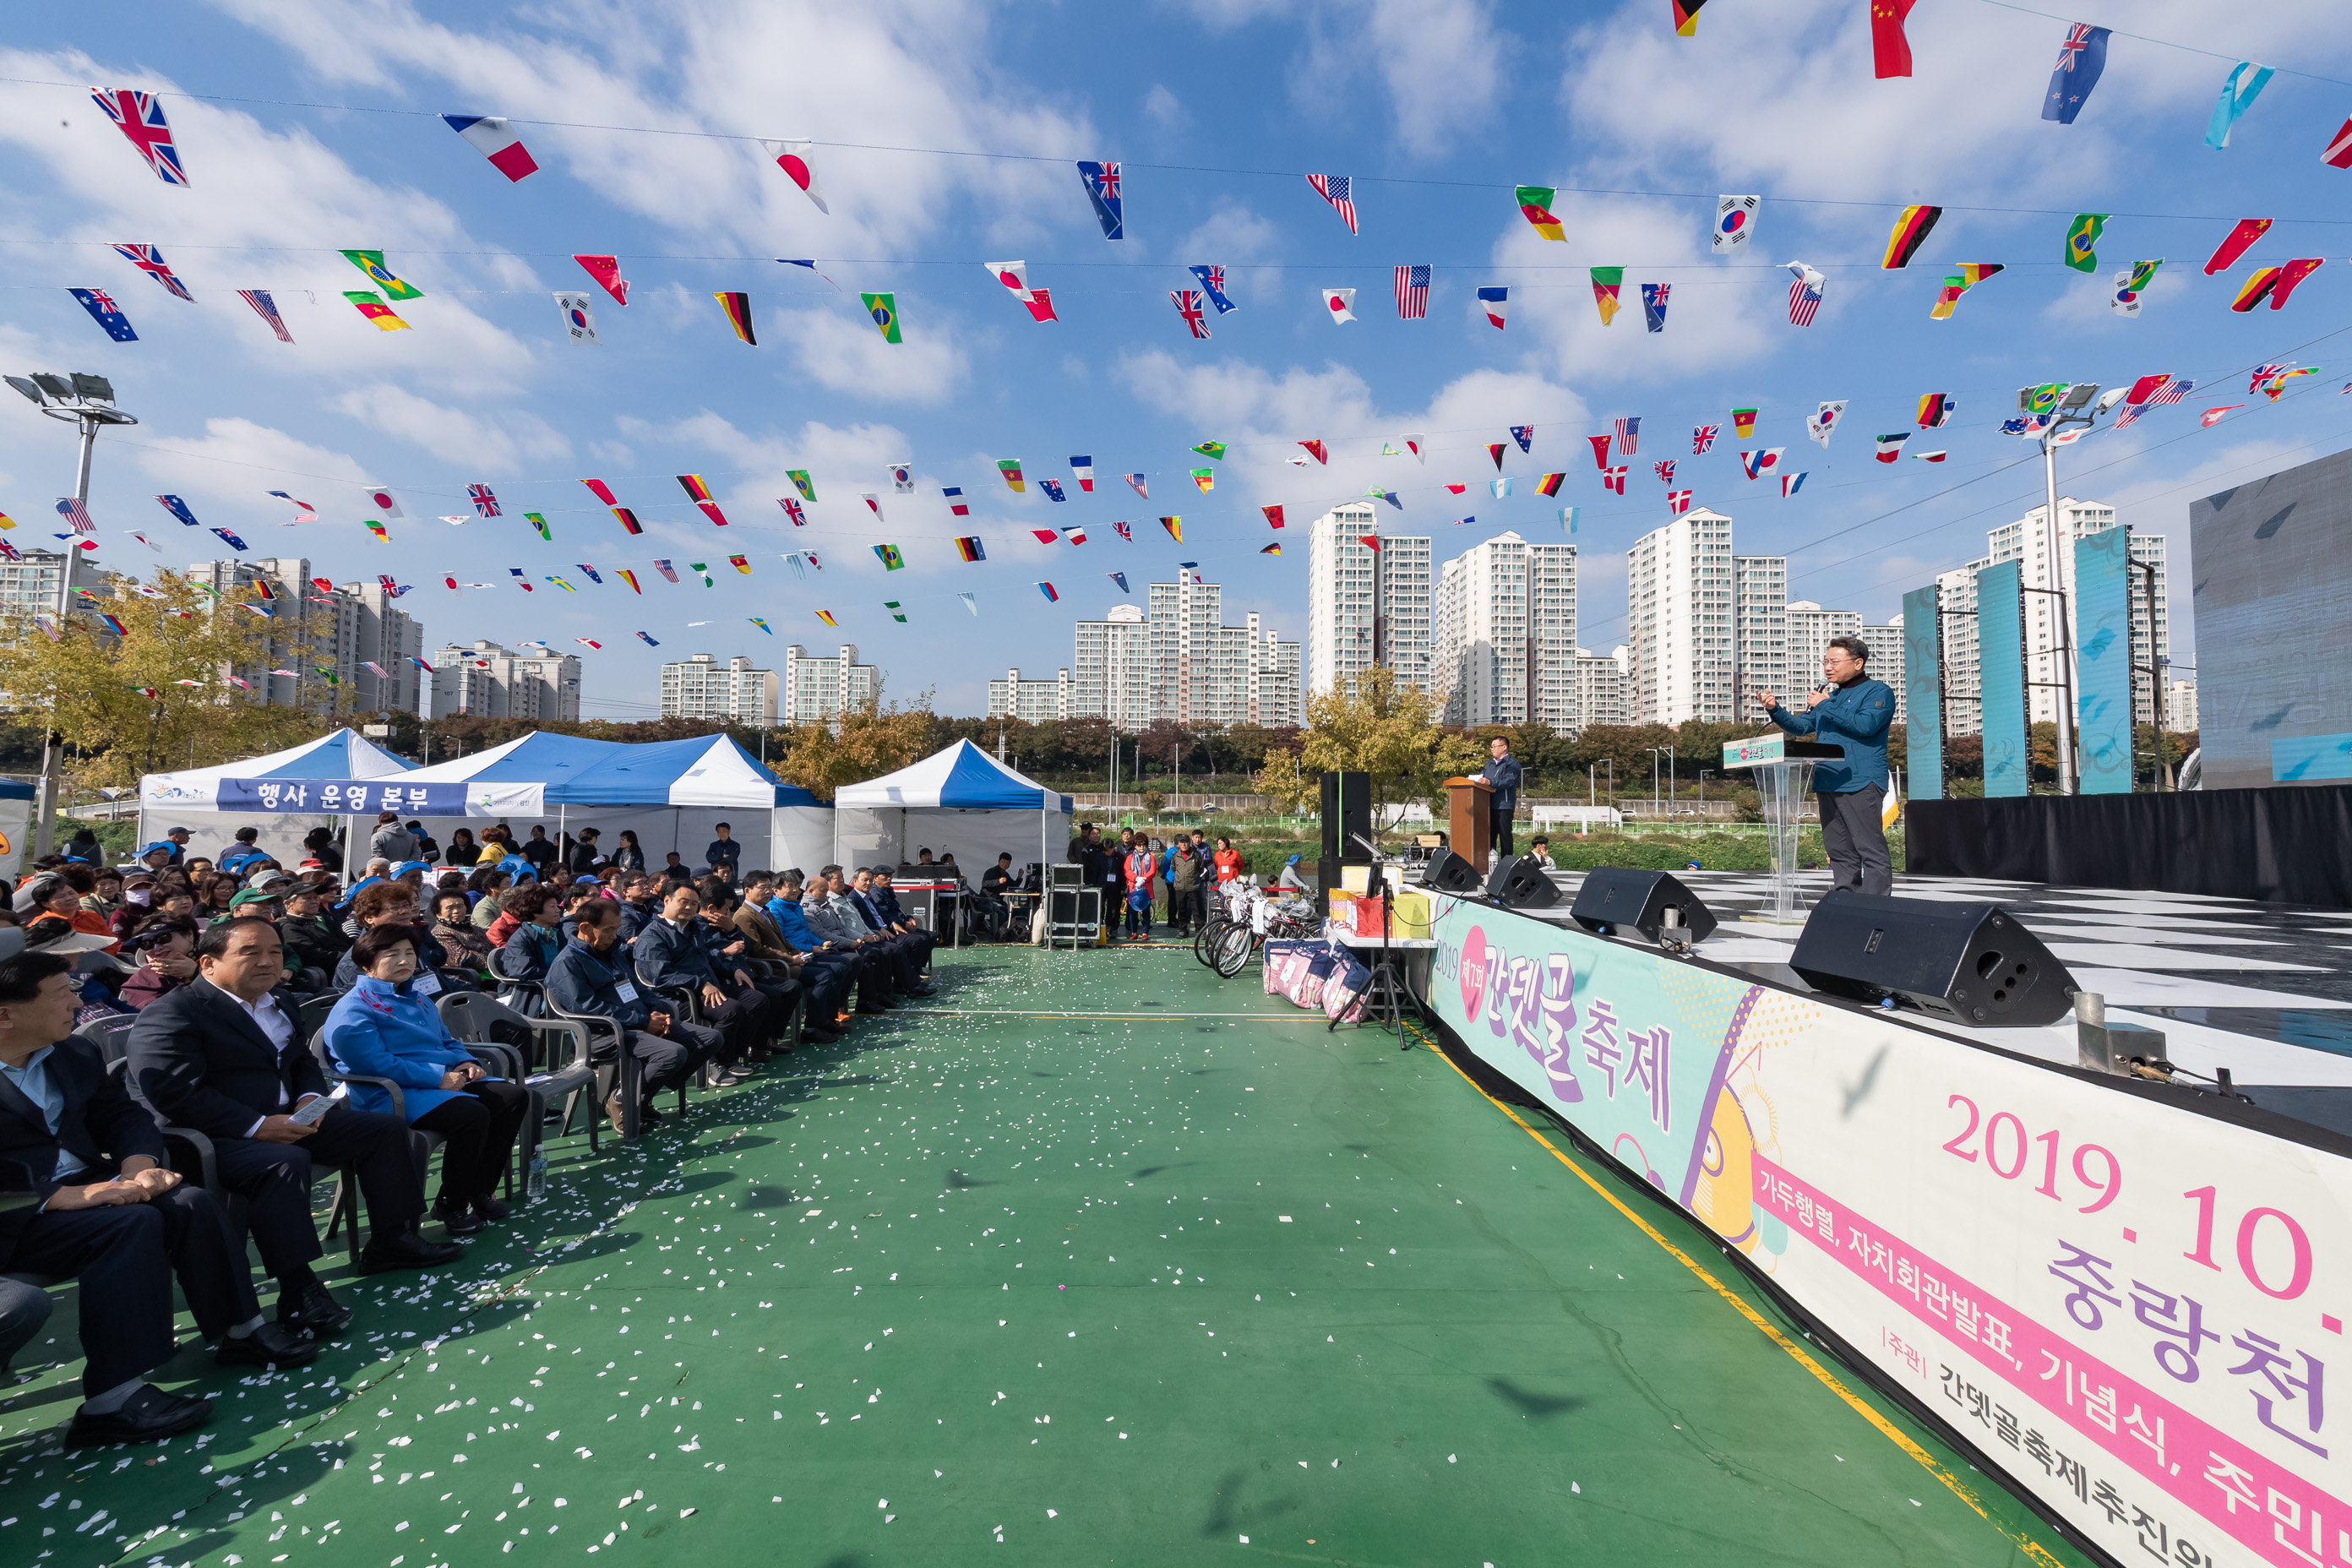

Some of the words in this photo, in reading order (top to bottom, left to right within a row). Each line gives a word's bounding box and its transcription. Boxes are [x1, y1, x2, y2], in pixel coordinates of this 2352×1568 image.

[258, 782, 307, 808] 행사
[320, 784, 368, 811] 운영
[380, 787, 428, 811] 본부
[1435, 939, 1459, 983] 2019
[1461, 958, 1484, 997] 제7회
[1484, 945, 1581, 1094] 간뎃골
[1581, 997, 1671, 1135] 축제
[1760, 1169, 1840, 1248] 가두행렬,
[1848, 1225, 2023, 1373] 자치회관발표,
[2039, 1348, 2180, 1478] 기념식,
[1942, 1094, 2137, 1244] 2019.
[2183, 1185, 2342, 1335] 10.
[2047, 1239, 2328, 1460] 중랑천
